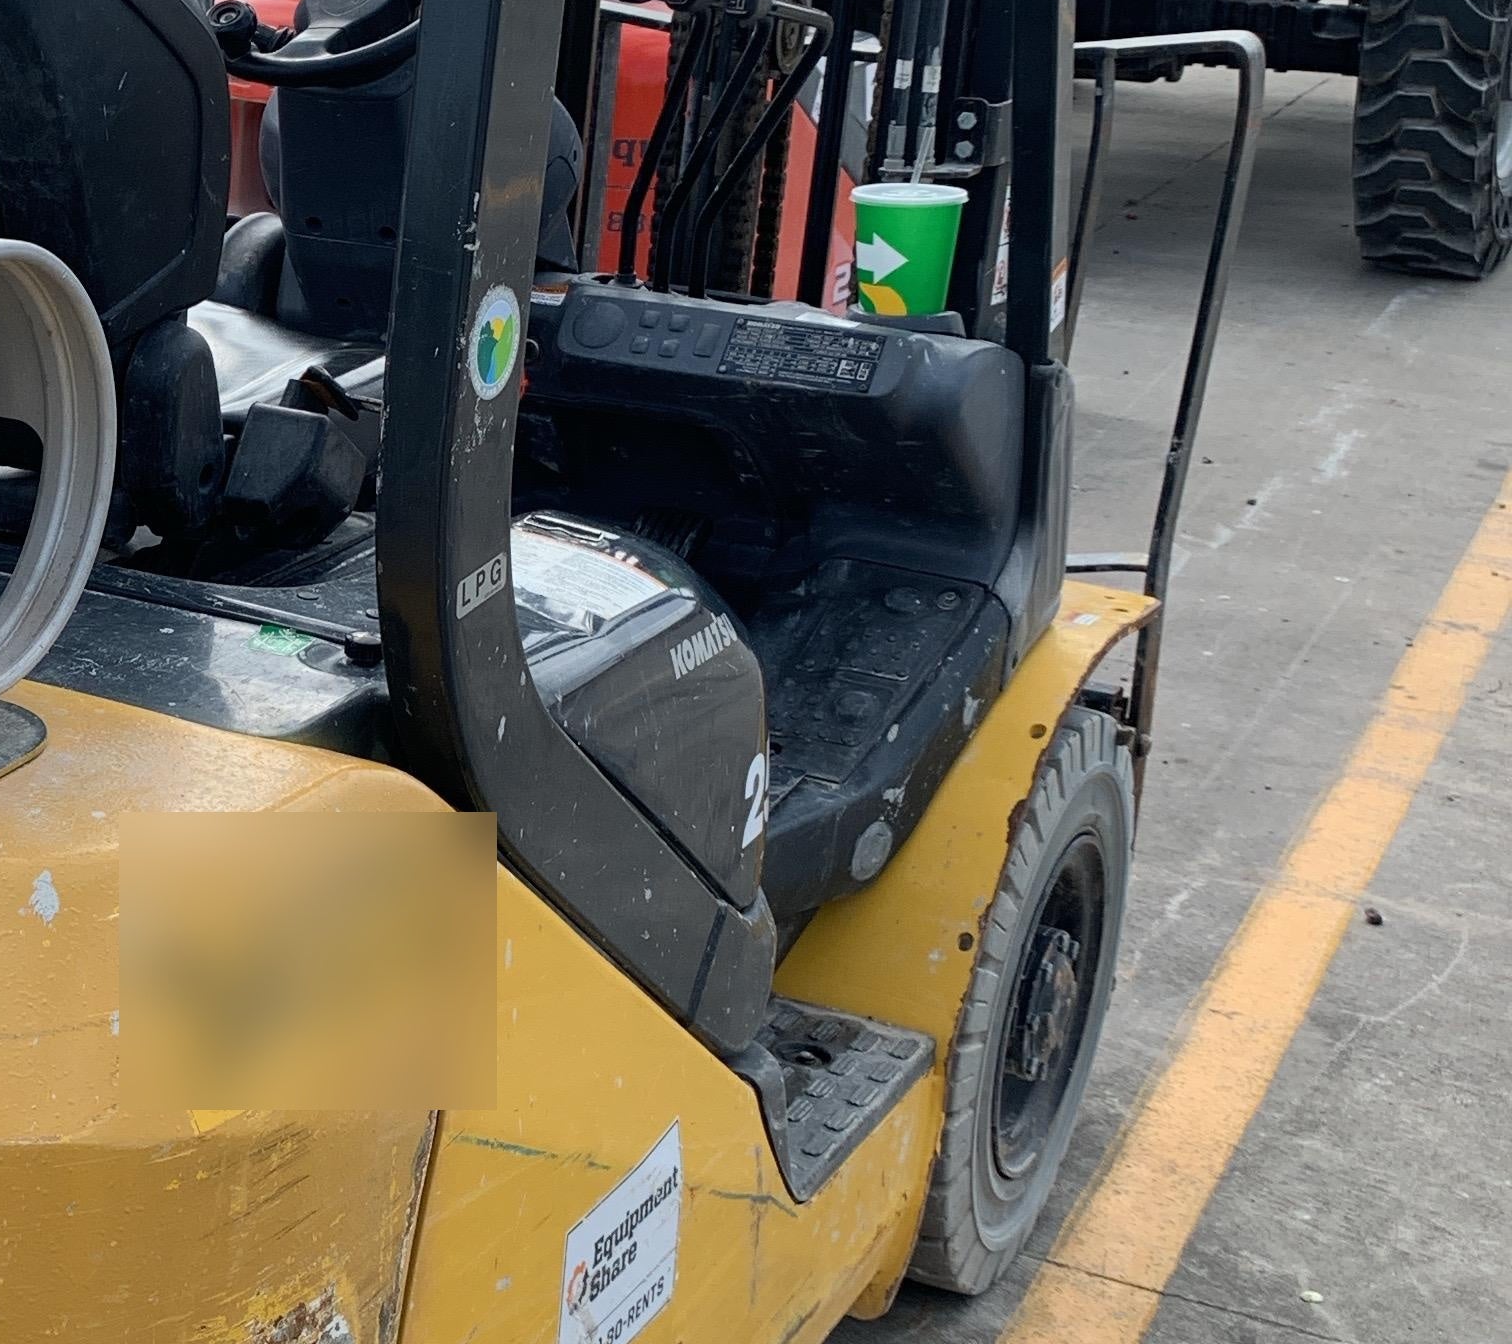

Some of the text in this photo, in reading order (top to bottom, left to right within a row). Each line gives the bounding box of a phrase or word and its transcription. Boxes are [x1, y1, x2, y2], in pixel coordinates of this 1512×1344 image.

[462, 558, 502, 607] LPG
[669, 612, 738, 680] KOMATSU
[742, 738, 770, 849] 2
[592, 1166, 679, 1269] Equipment
[589, 1241, 638, 1303] Share
